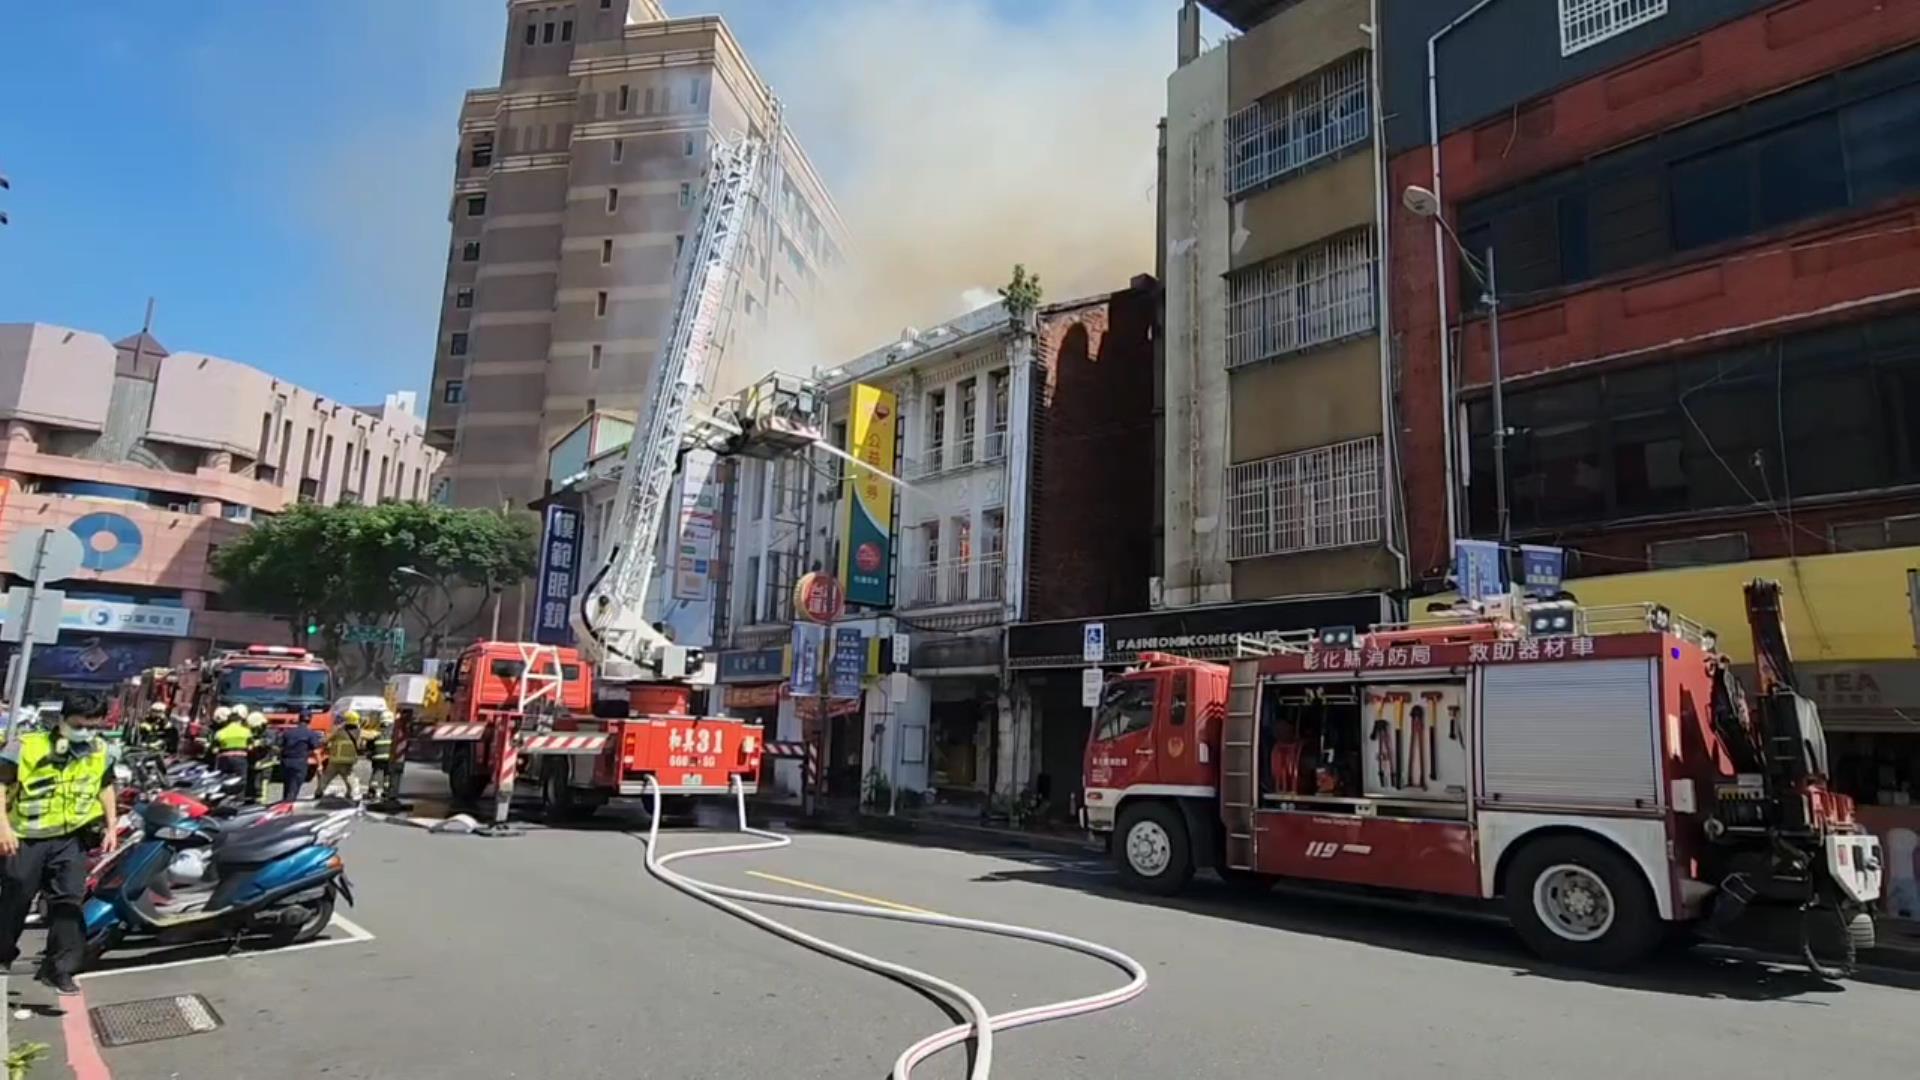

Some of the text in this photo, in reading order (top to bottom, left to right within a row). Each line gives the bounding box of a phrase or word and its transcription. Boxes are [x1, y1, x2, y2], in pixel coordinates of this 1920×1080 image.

[543, 511, 576, 629] 模範眼鏡
[1303, 636, 1595, 671] 彰化縣消防局 救助器材車
[1815, 673, 1881, 693] TEA
[1305, 840, 1339, 858] 119
